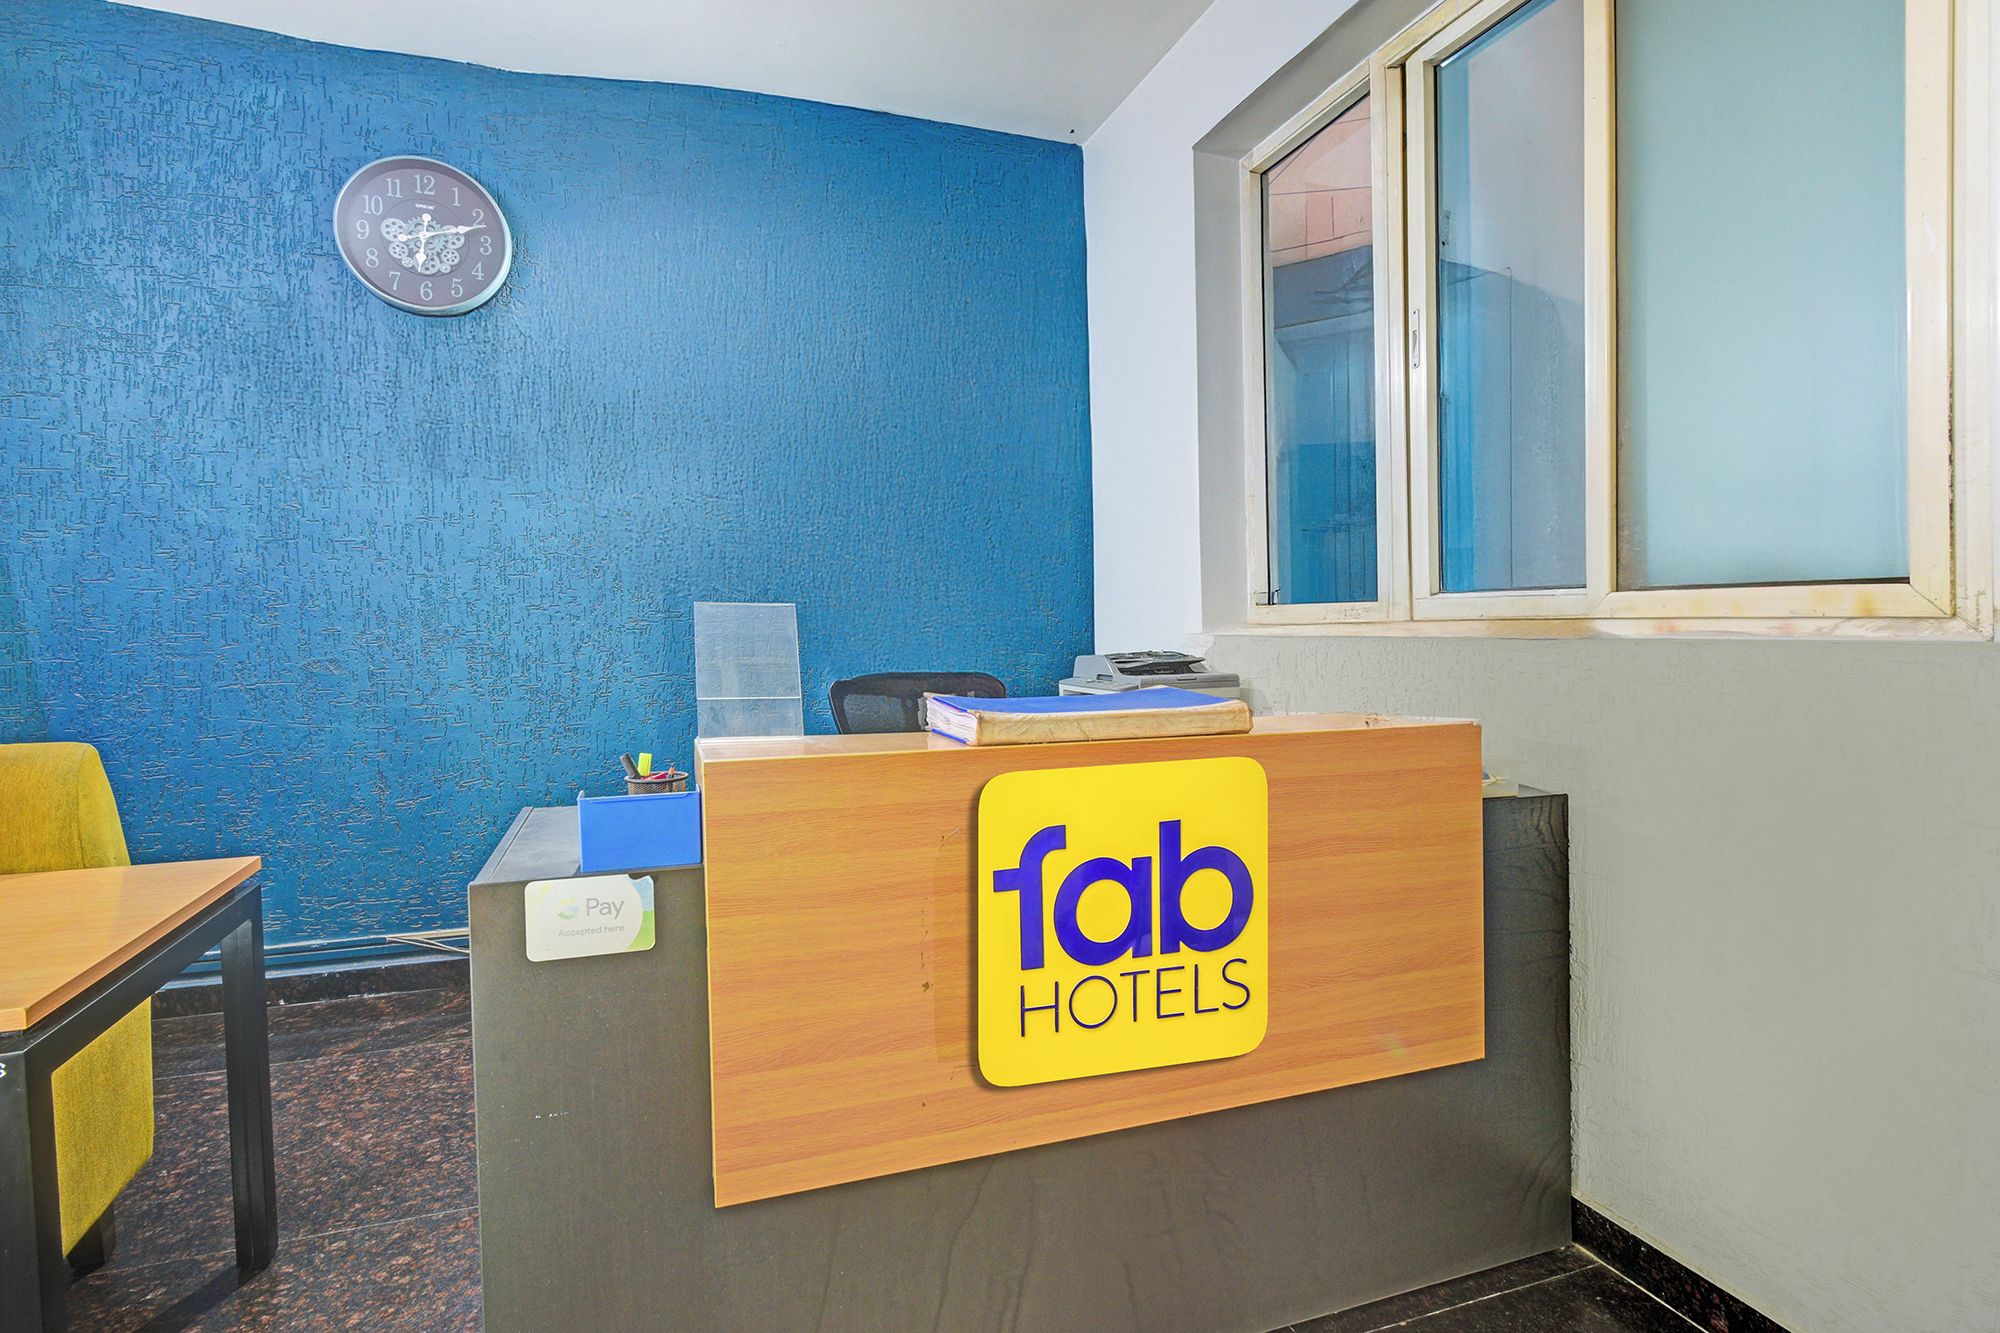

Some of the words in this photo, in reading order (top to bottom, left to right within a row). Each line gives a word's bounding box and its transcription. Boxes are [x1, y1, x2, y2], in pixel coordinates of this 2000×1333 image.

[386, 177, 403, 198] 11
[413, 174, 435, 195] 12
[362, 194, 383, 215] 10
[452, 187, 461, 207] 1
[472, 208, 485, 227] 2
[356, 219, 370, 239] 9
[479, 235, 492, 256] 3
[366, 247, 379, 268] 8
[388, 271, 401, 291] 7
[471, 262, 485, 281] 4
[420, 281, 433, 301] 6
[451, 278, 464, 298] 5
[993, 819, 1254, 971] fab
[586, 898, 625, 919] Pay
[558, 926, 602, 937] Accepted
[604, 924, 625, 933] here
[1020, 957, 1251, 1037] HOTELS
